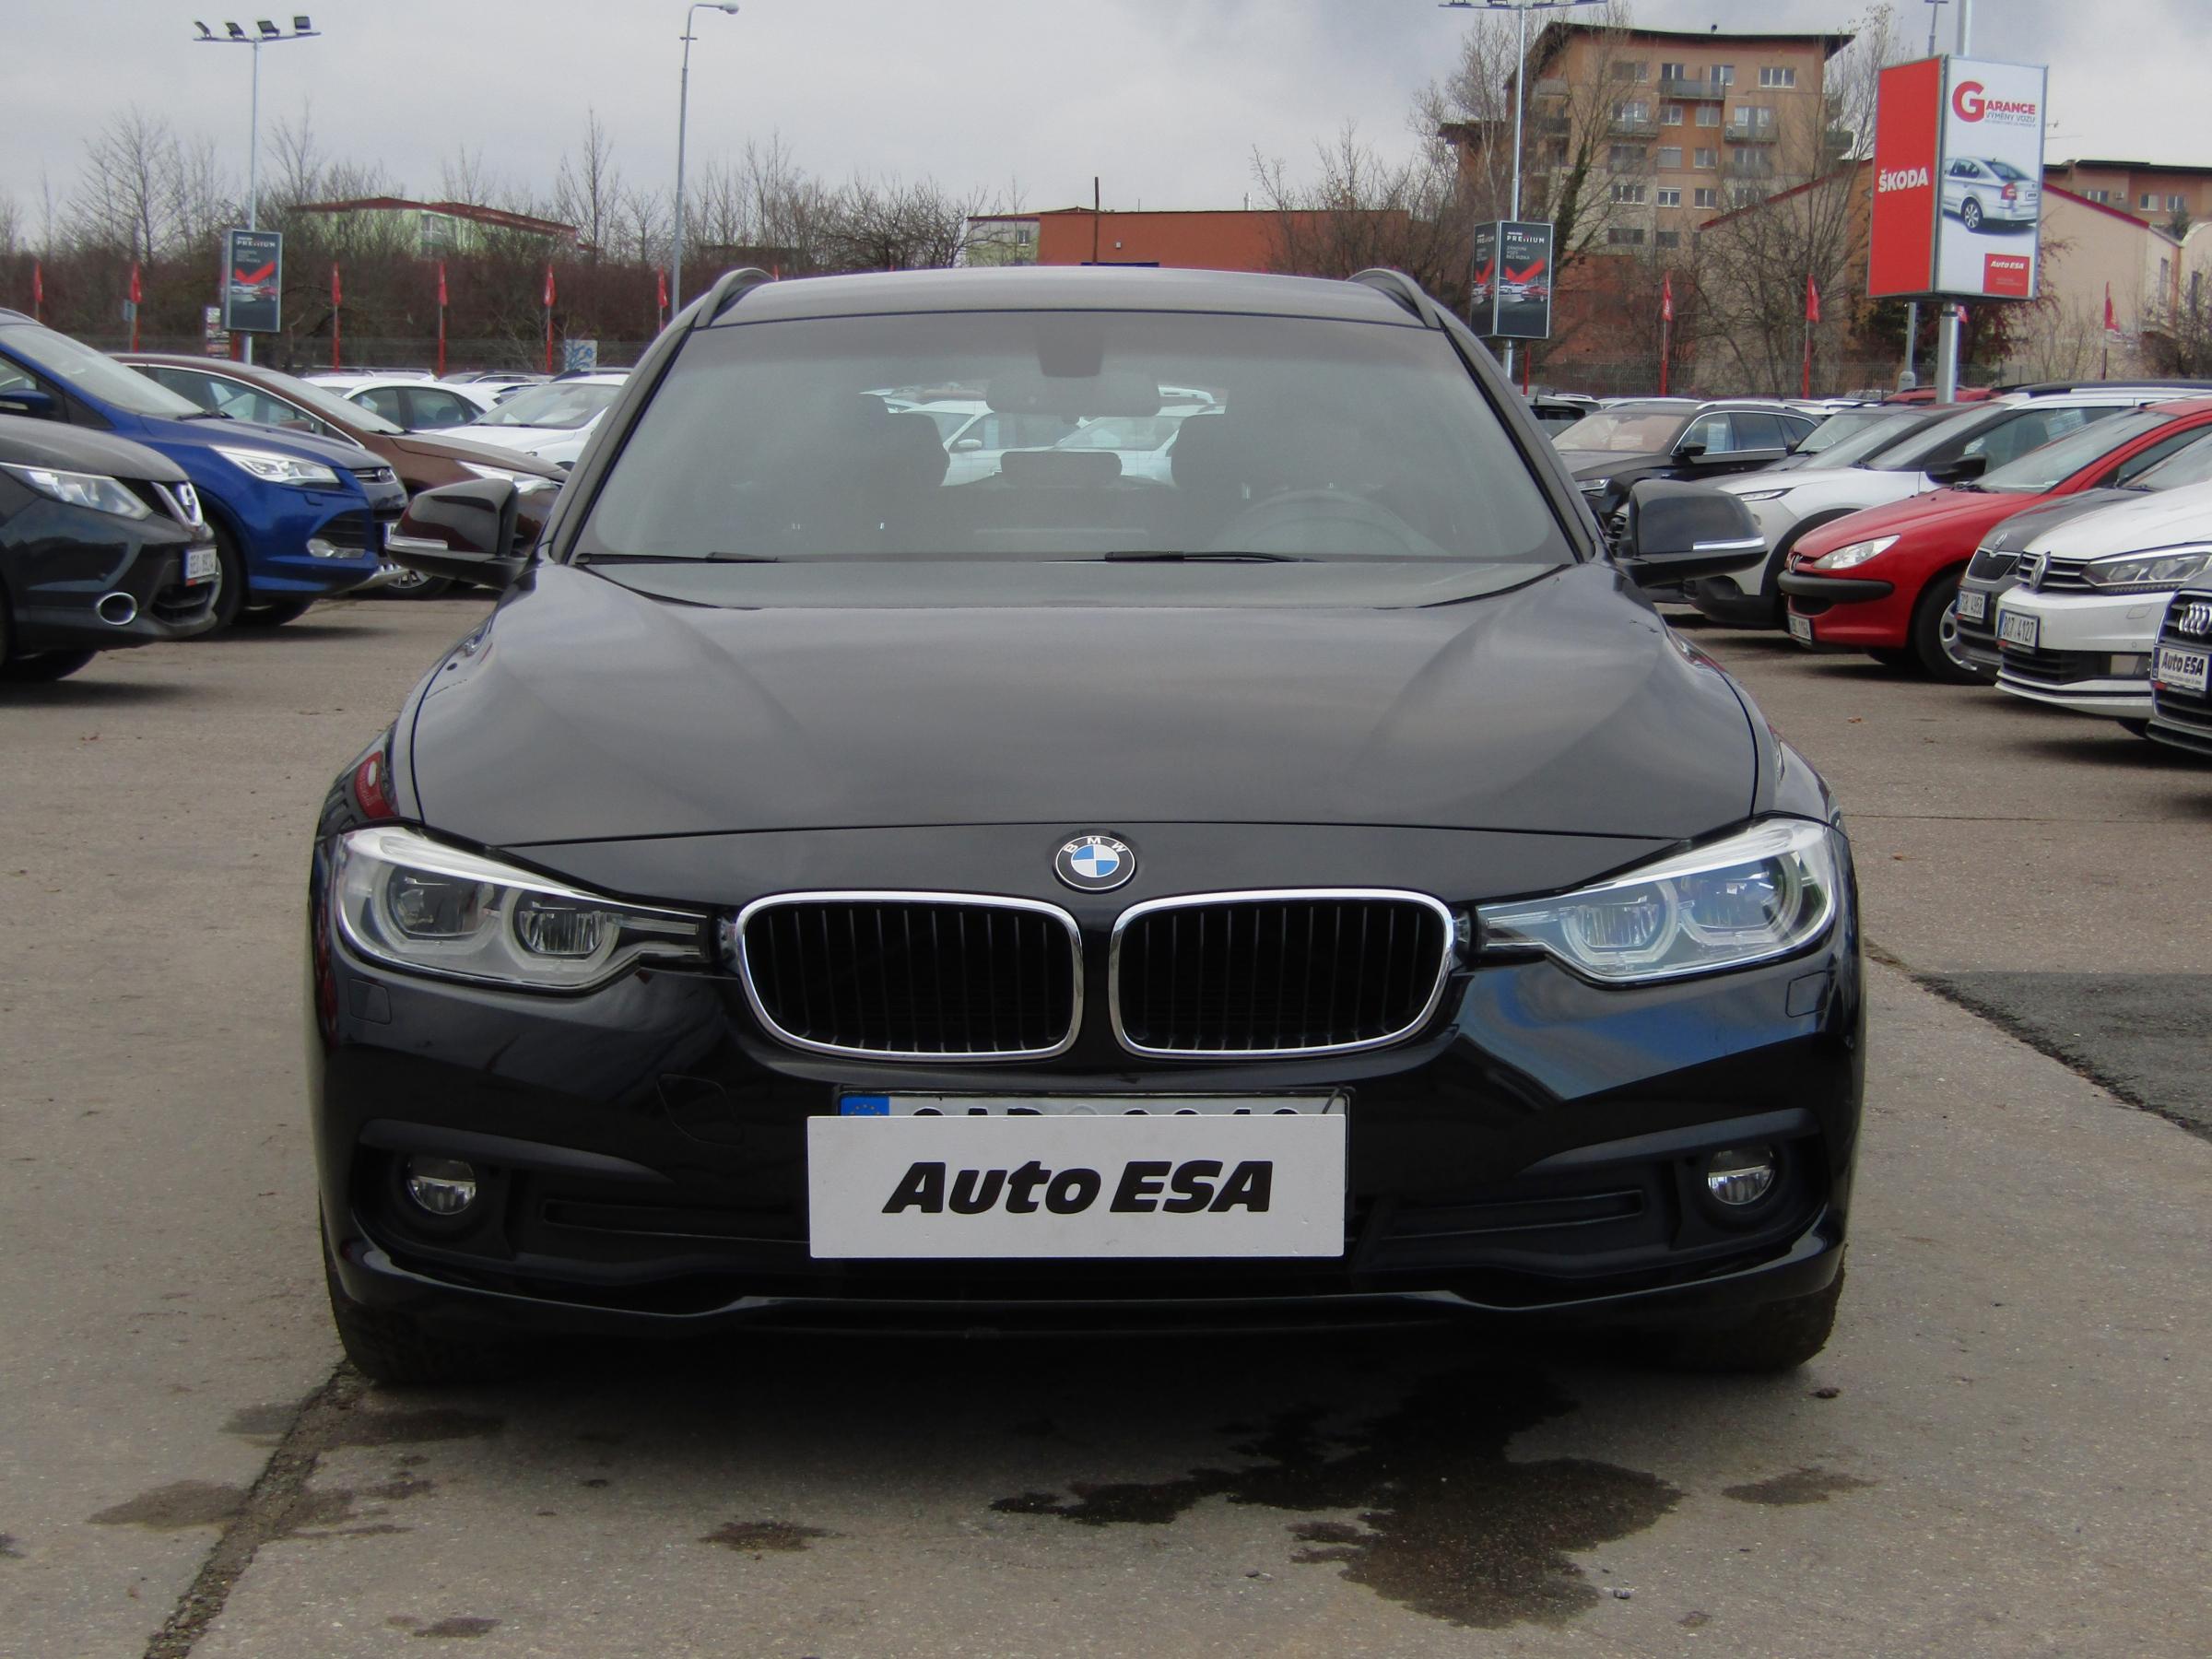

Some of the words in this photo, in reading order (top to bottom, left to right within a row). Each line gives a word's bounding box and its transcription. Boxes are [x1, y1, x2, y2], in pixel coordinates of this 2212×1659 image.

[1952, 81, 2035, 123] GARANCE
[1878, 168, 1928, 193] ŠKODA
[1506, 235, 1545, 244] PREMIUM
[2161, 652, 2183, 672] Auto
[2183, 655, 2204, 677] ESA
[1064, 837, 1125, 853] BMW
[881, 1160, 1101, 1215] Auto
[1110, 1159, 1273, 1213] ESA
